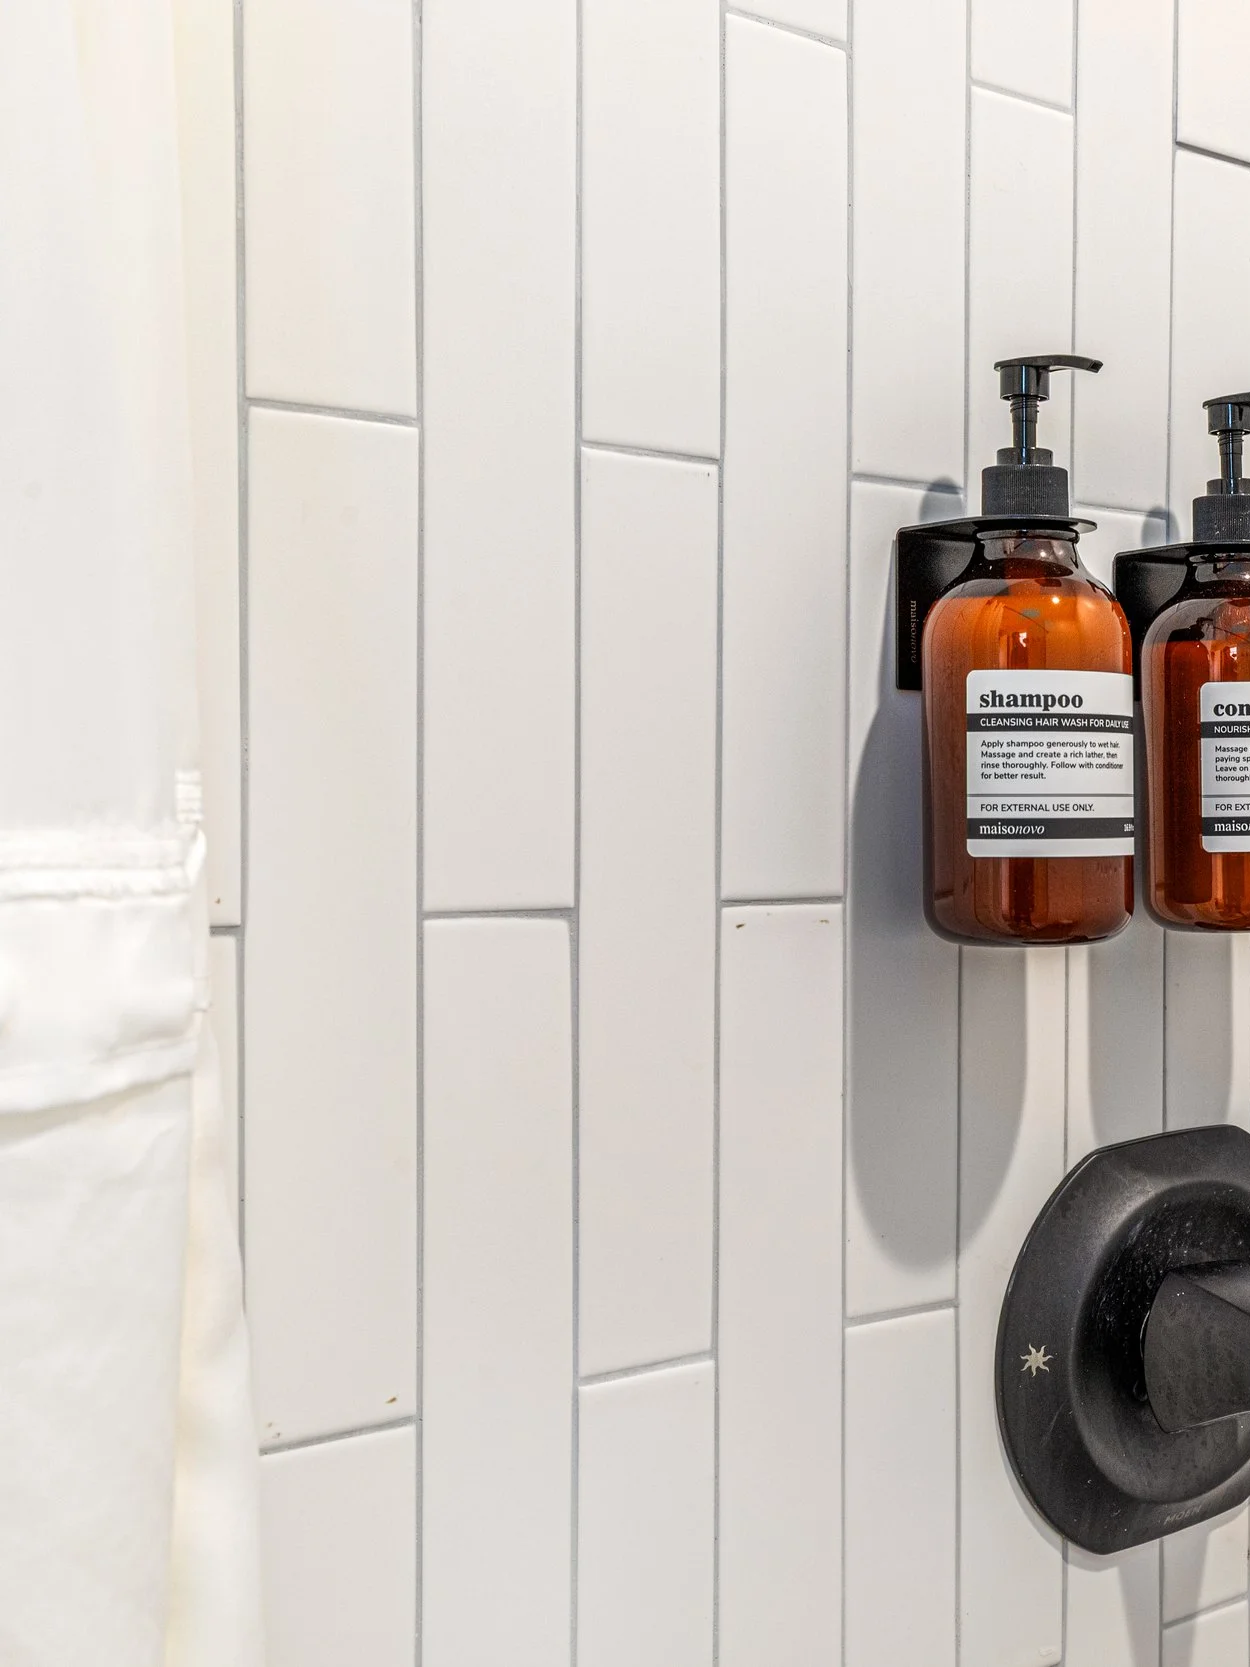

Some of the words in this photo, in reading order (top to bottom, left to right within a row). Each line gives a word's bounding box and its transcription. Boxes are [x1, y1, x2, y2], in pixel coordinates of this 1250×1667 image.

[910, 600, 919, 663] maisonovo
[980, 690, 1083, 711] shampoo
[980, 718, 1033, 727] CLEANSING
[1036, 718, 1058, 727] HAIR
[1061, 719, 1087, 727] WASH
[1090, 719, 1104, 727] FOR
[981, 740, 1004, 749] Apply
[1006, 740, 1044, 748] shampoo
[1046, 740, 1087, 749] generously
[1215, 755, 1240, 763] paying
[1002, 761, 1048, 770] thoroughly.
[1051, 761, 1077, 769] Follow
[980, 822, 1045, 835] maisonovo
